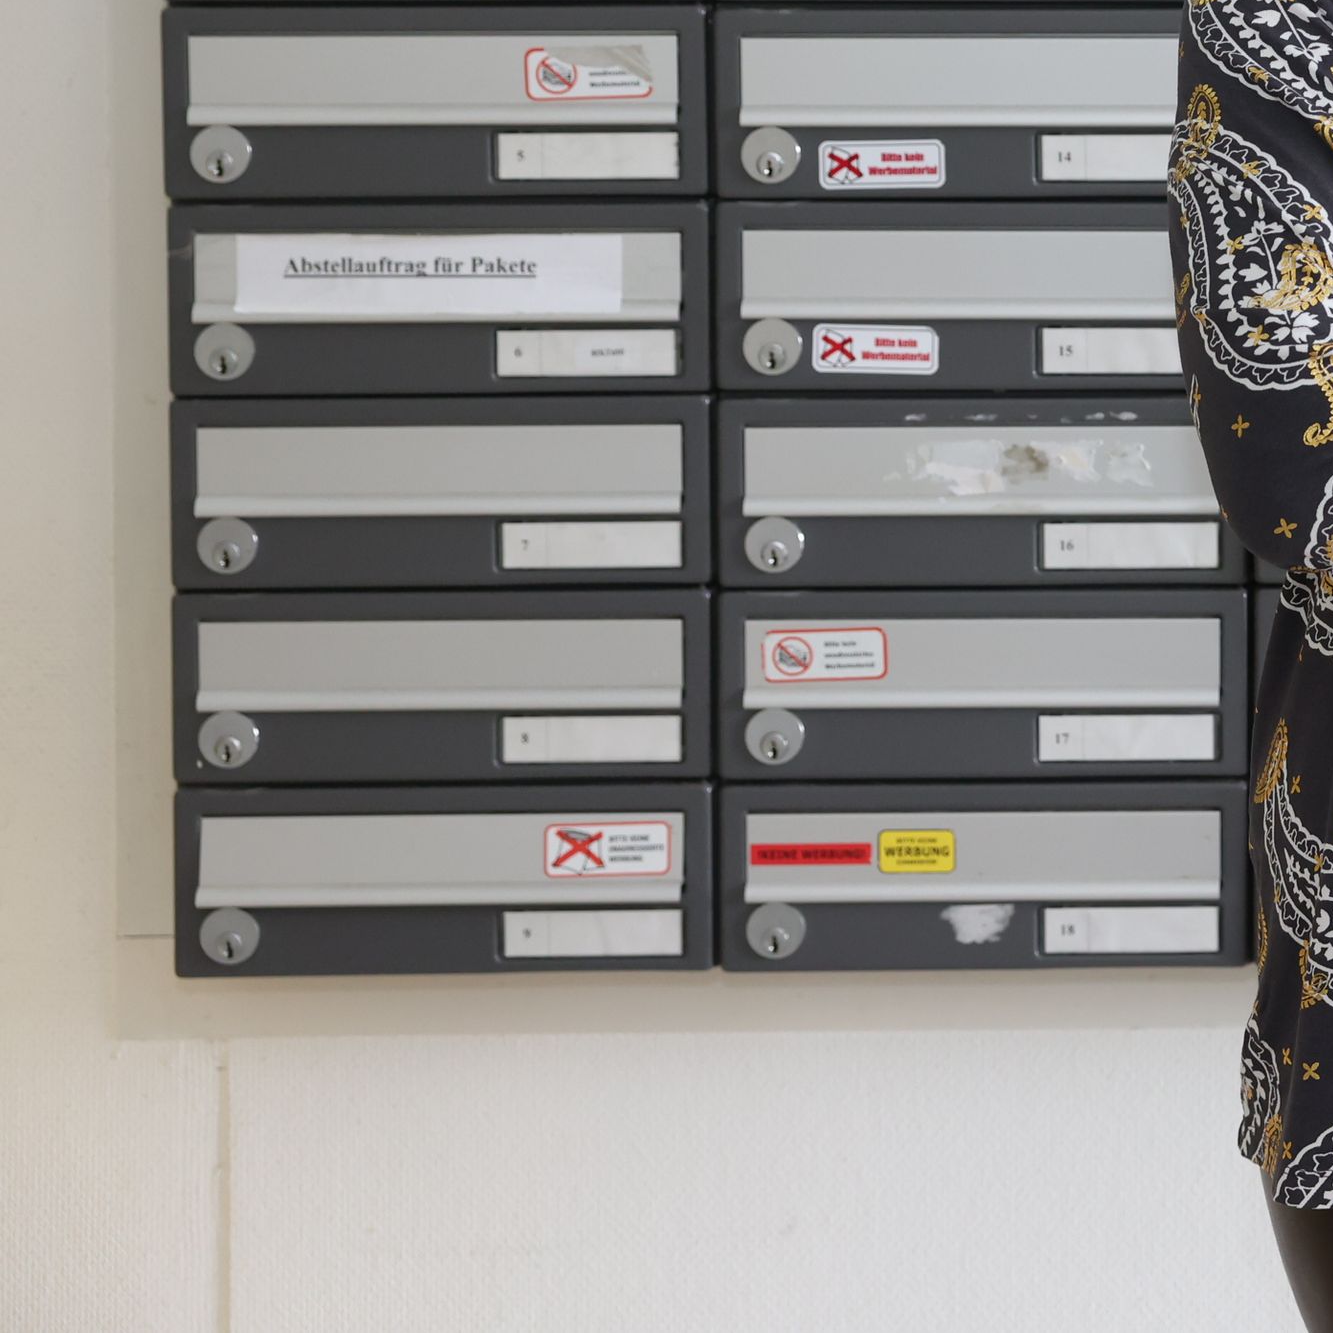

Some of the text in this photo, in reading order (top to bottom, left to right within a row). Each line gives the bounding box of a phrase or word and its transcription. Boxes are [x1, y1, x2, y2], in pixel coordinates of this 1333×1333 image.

[516, 149, 525, 161] 5
[881, 152, 902, 162] Bitte
[1058, 151, 1072, 163] 14
[868, 166, 938, 176] Werbematerial
[285, 256, 538, 277] Abstellauftrag für Pakete
[875, 337, 896, 347] Bitte
[513, 345, 523, 358] 6
[862, 351, 931, 362] Werbematerial
[1059, 344, 1074, 357] 15
[521, 538, 530, 550] 7
[1060, 539, 1075, 552] 16
[521, 732, 529, 744] 8
[1055, 732, 1070, 745] 17
[884, 846, 951, 859] WERBUNG
[522, 927, 532, 939] 9
[1061, 924, 1076, 936] 18
